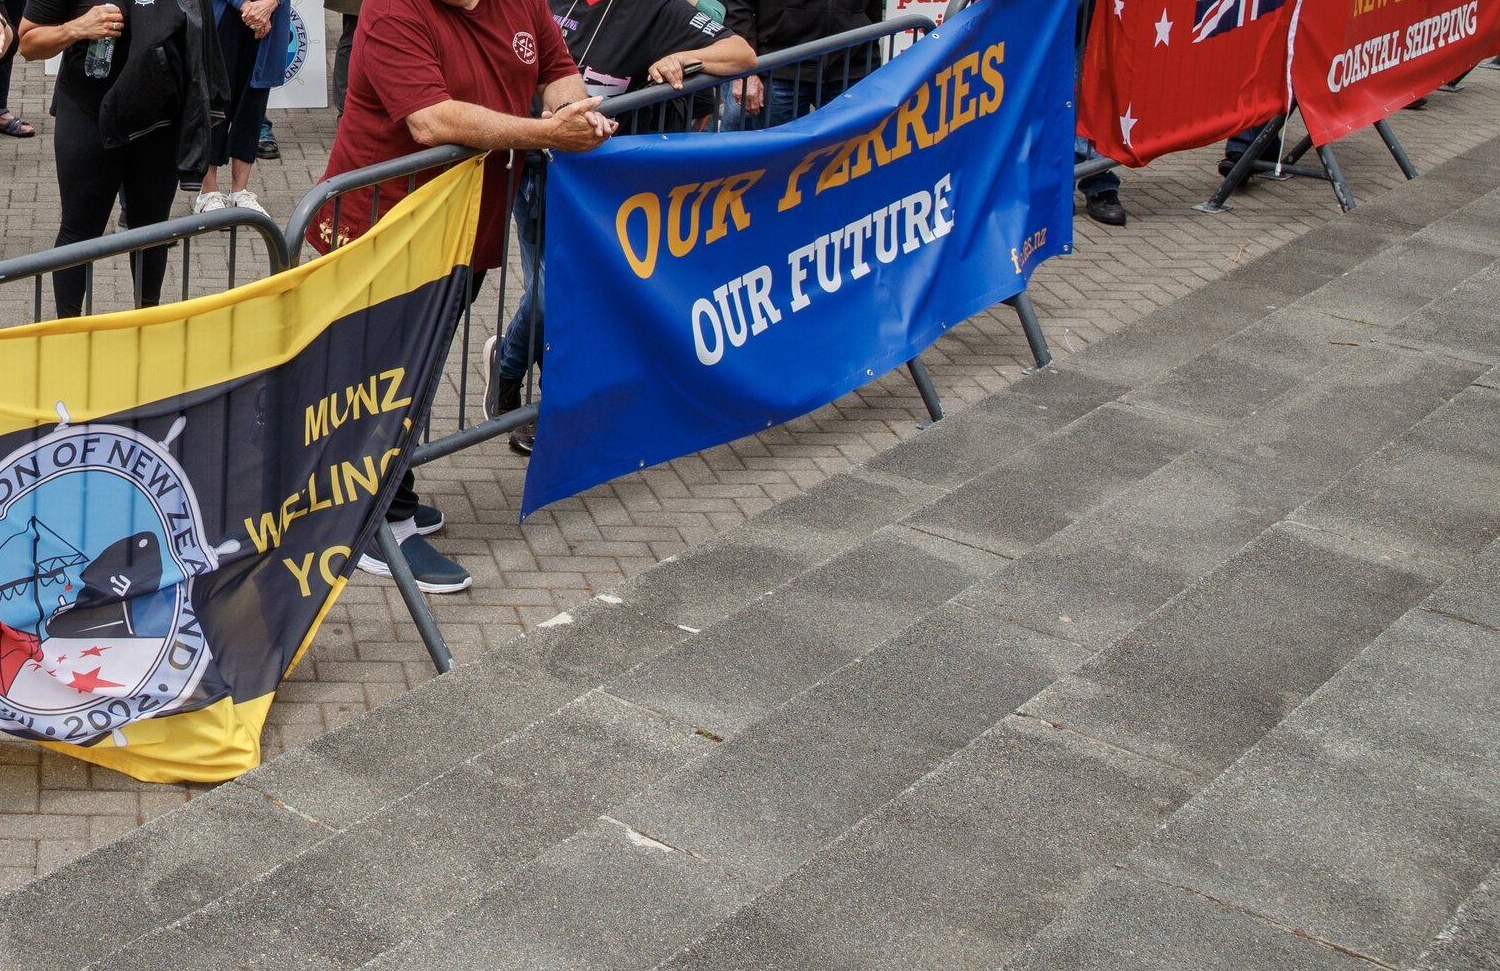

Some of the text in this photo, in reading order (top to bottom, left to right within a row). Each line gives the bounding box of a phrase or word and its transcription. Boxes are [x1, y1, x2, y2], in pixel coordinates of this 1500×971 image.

[284, 23, 307, 82] ZEALAND
[1327, 0, 1479, 94] COASTAL SHIPPING
[615, 168, 767, 279] OUR
[690, 172, 956, 366] OUR FUTURE
[304, 367, 413, 447] MUNZ
[52, 437, 102, 468] OF
[106, 440, 180, 500] NEW
[62, 692, 161, 740] 2002
